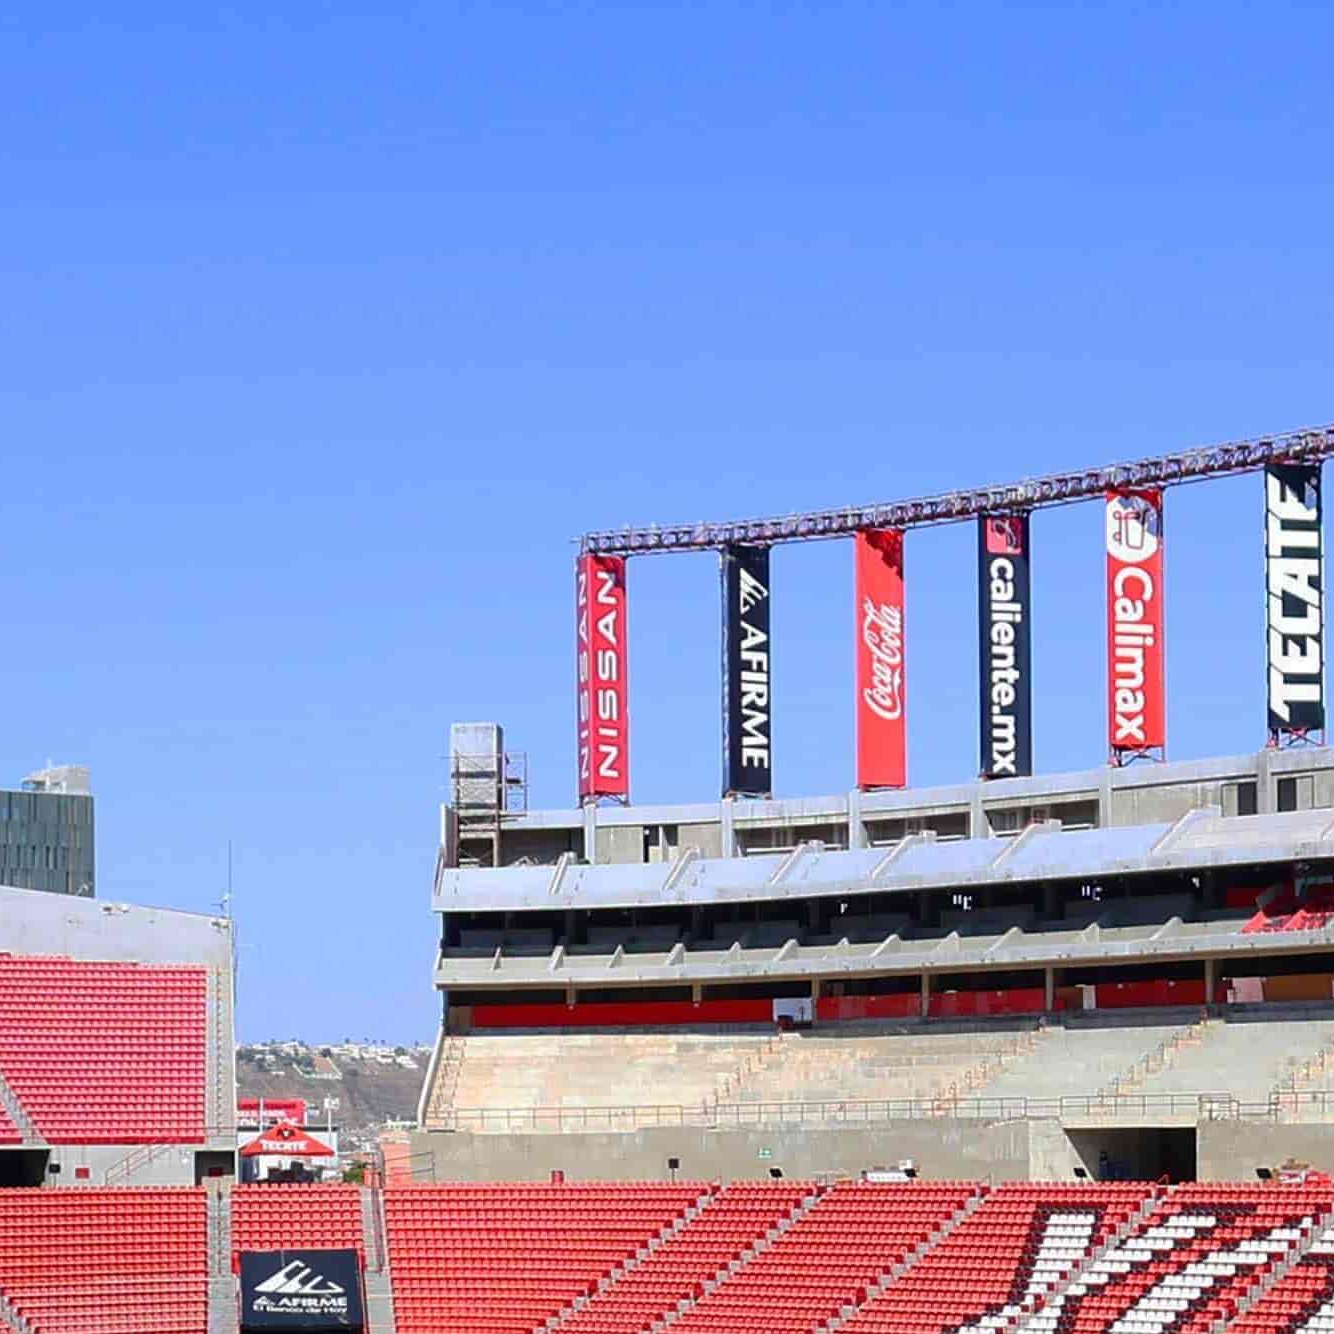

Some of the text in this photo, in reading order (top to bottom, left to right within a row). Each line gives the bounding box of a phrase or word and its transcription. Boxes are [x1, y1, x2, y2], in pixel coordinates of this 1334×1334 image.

[596, 571, 620, 778] NISSAN
[740, 619, 769, 768] AFIRME
[989, 556, 1022, 774] caliente.mx
[1113, 566, 1156, 741] Calimax
[1266, 474, 1323, 724] TECATE
[278, 1296, 348, 1307] AFIRME
